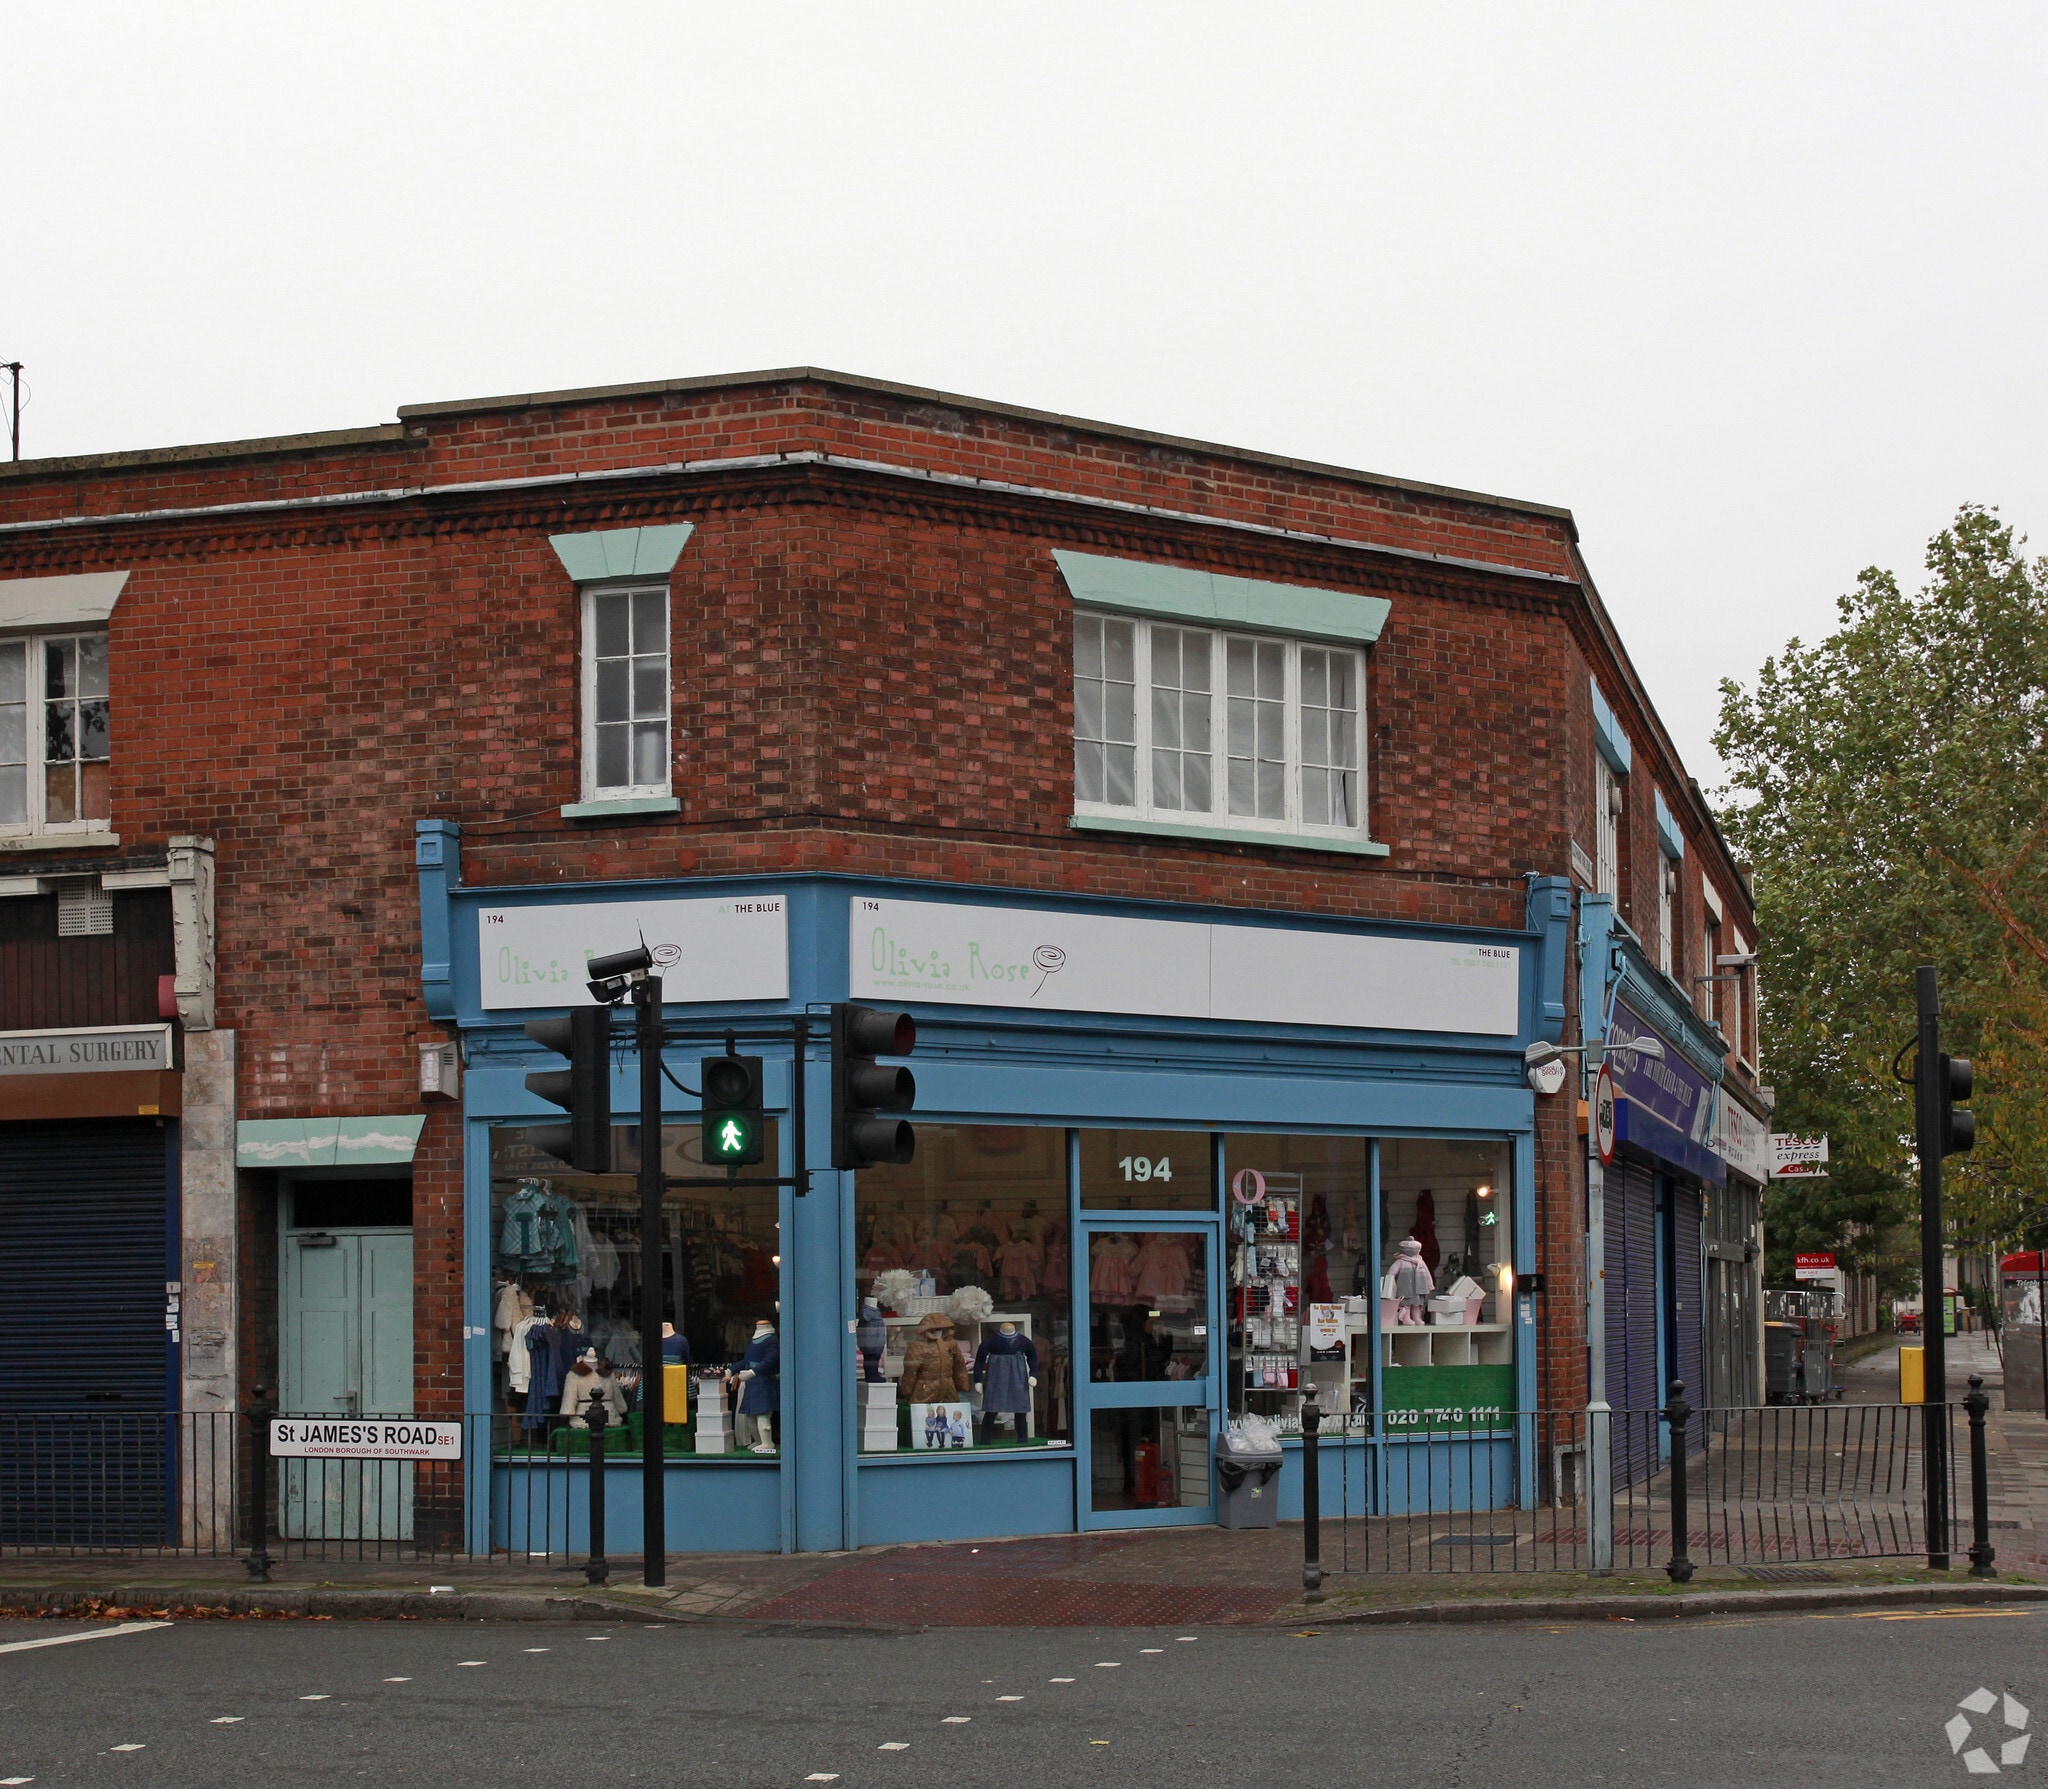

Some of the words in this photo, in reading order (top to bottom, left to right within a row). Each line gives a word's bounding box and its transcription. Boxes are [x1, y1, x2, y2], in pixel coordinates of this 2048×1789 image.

[735, 903, 753, 913] THE
[756, 902, 780, 912] BLUE
[862, 901, 879, 911] 194
[486, 915, 504, 924] 194
[872, 927, 949, 979] Olivia
[968, 941, 1030, 982] Rose
[1478, 948, 1491, 957] THE
[1493, 949, 1510, 959] BLUE
[499, 946, 568, 984] Olivia
[0, 1044, 61, 1065] NTAL
[70, 1040, 159, 1063] SURGERY
[1775, 1137, 1820, 1146] TESCO
[1777, 1151, 1820, 1162] express
[1119, 1156, 1172, 1182] 194
[1788, 1165, 1810, 1173] Cas
[1387, 1408, 1419, 1425] 020
[1423, 1407, 1464, 1424] 7740
[1469, 1406, 1500, 1422] 1111
[277, 1424, 295, 1442] St
[300, 1425, 378, 1444] JAMES'S
[384, 1426, 437, 1445] ROAD
[437, 1435, 455, 1445] SE1
